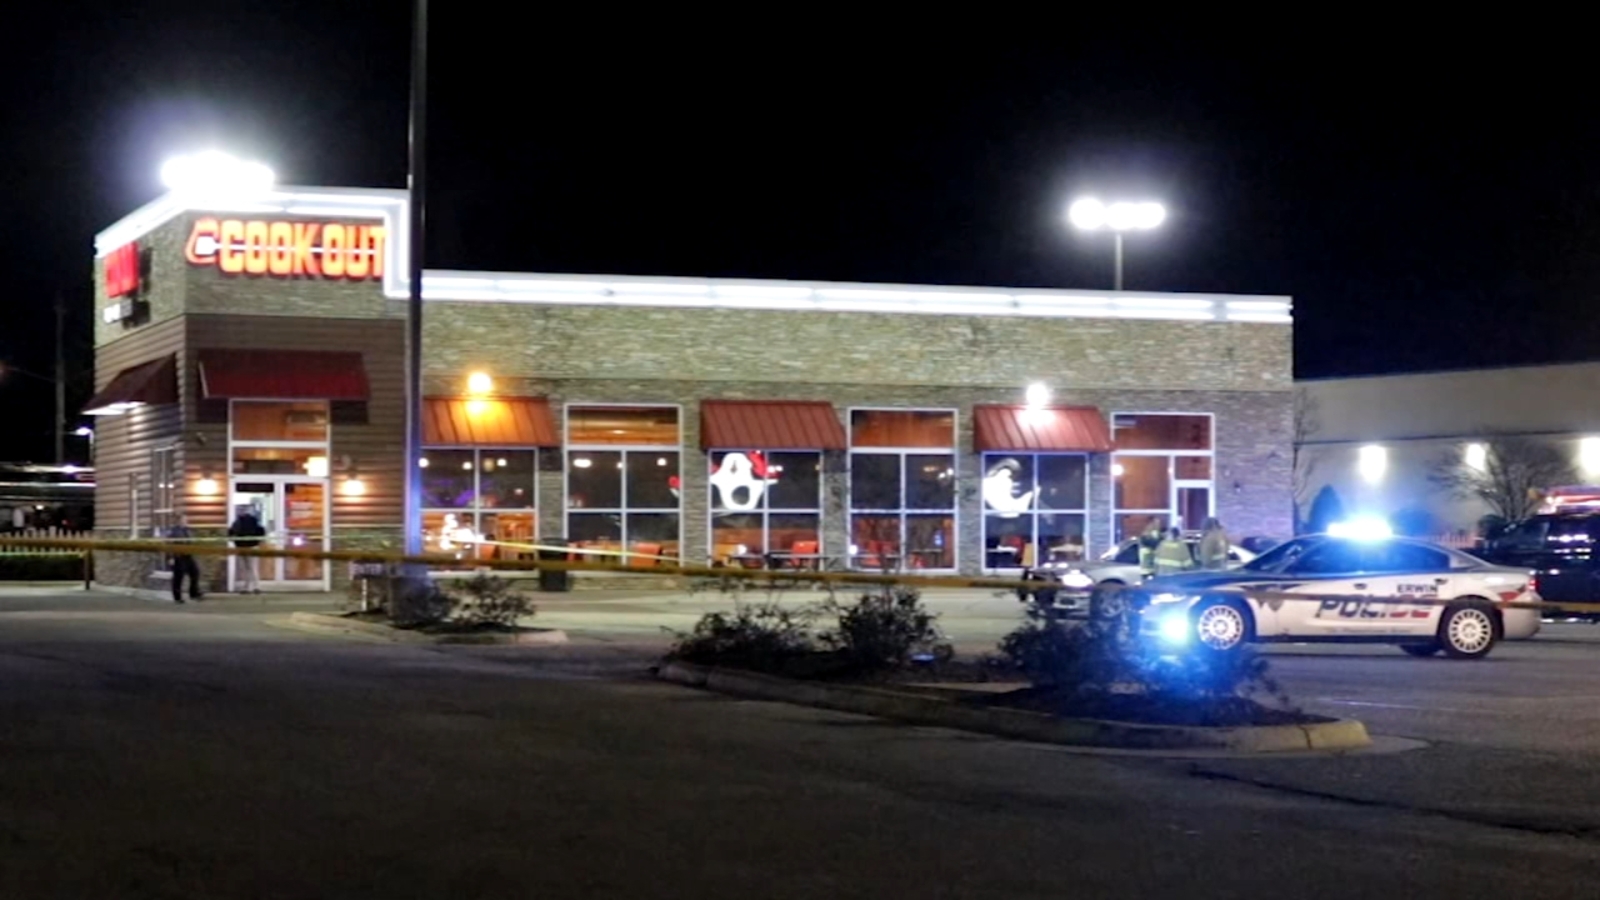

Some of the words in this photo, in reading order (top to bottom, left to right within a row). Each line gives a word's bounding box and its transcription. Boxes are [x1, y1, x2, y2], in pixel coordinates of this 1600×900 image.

[219, 219, 320, 277] COOK
[322, 222, 386, 278] OUT
[1397, 584, 1438, 594] ERWIN
[1315, 594, 1438, 618] POLICE
